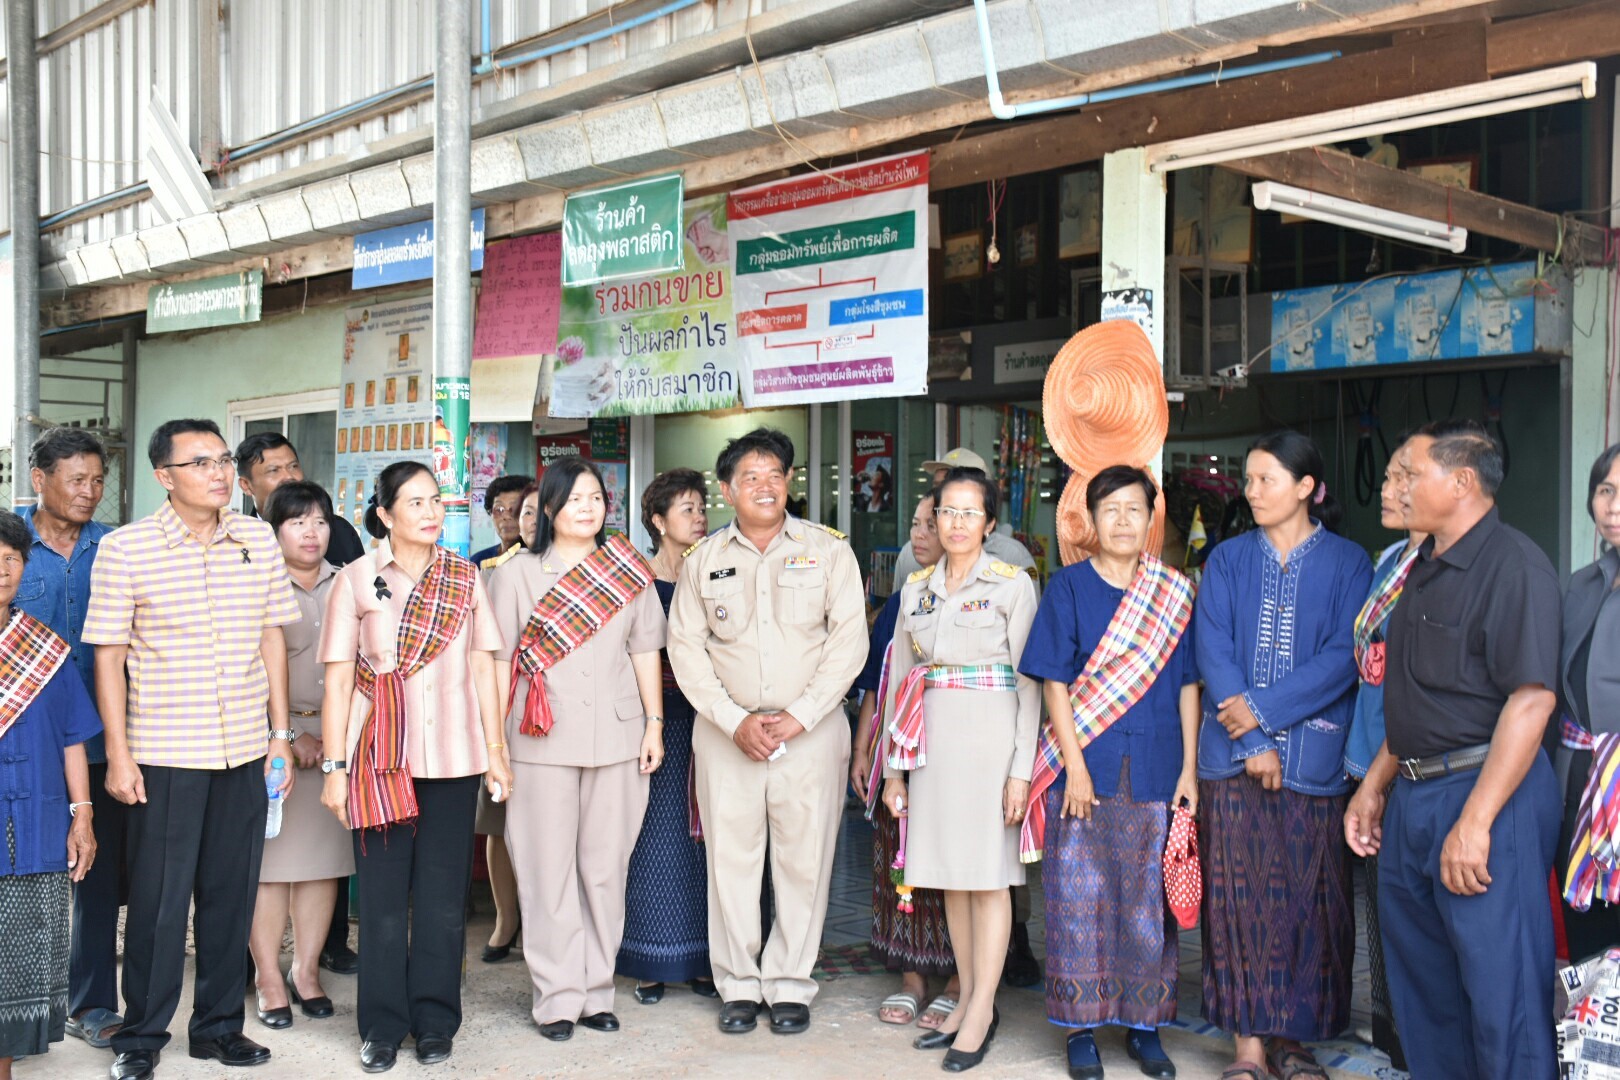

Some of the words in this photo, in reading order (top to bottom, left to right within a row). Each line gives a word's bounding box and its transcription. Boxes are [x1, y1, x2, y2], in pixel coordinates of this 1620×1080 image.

[596, 195, 645, 233] ร้านค้า
[568, 223, 673, 272] ลดถุงพลาสติก
[749, 229, 898, 271] กลุ่มออมทรัพย์เพื่อการผลิต
[595, 270, 723, 315] ร่วมกนขาย
[619, 311, 727, 357] ปันผลกำไร
[615, 362, 732, 401] ให้กับสมาชิก
